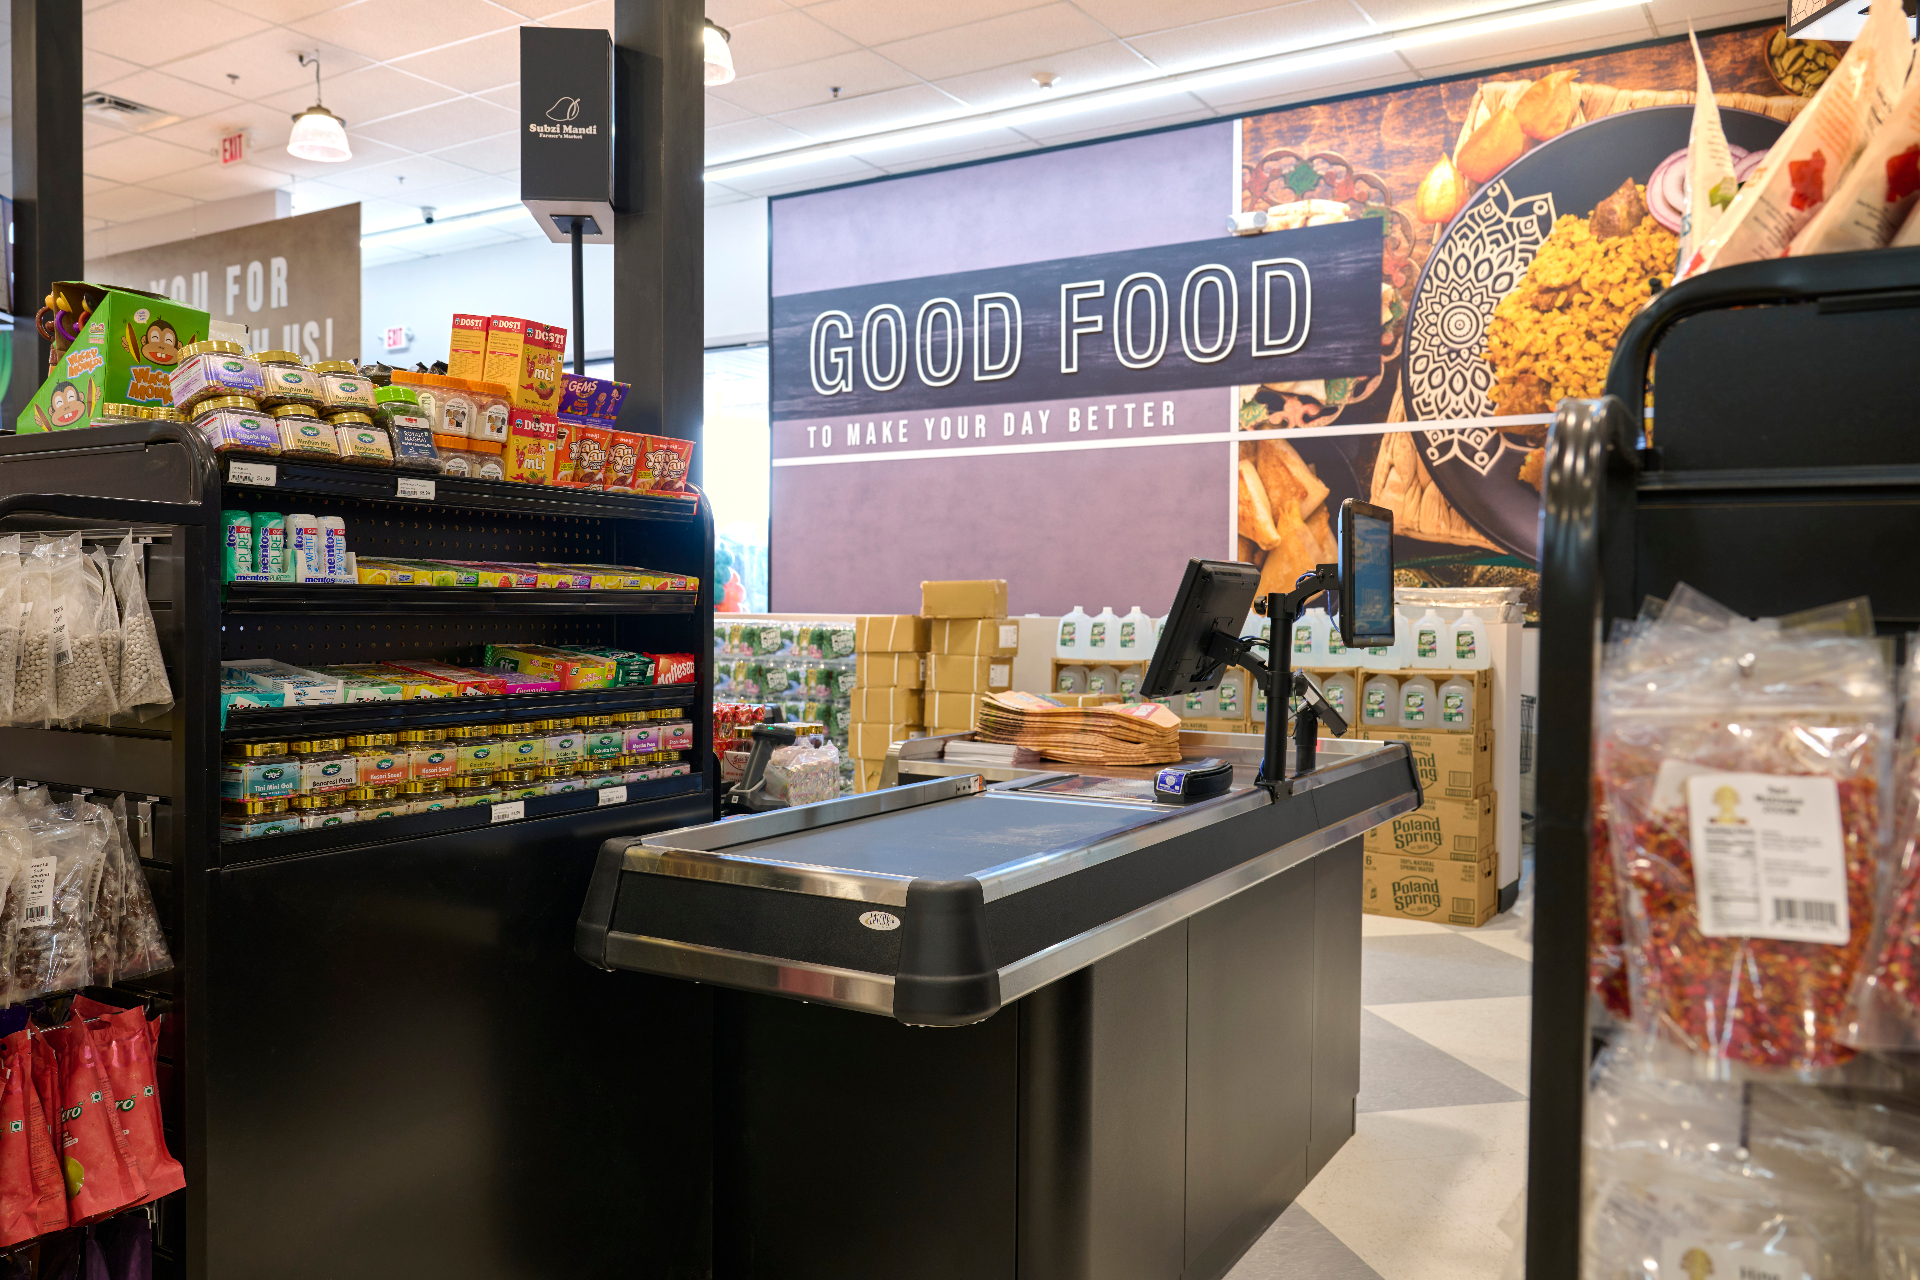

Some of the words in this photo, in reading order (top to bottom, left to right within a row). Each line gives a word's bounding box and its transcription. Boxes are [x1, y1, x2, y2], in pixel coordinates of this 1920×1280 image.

[529, 123, 560, 133] Subzi
[562, 124, 597, 135] Mandi
[226, 256, 288, 316] FOR
[460, 318, 482, 327] DOSTI
[499, 319, 521, 330] DOSTI
[809, 291, 1023, 396] GOOD
[1060, 257, 1312, 374] FOOD
[534, 329, 565, 345] DOSTI
[131, 367, 171, 386] WACK
[129, 381, 174, 406] MONK
[568, 380, 599, 393] GEMS
[524, 420, 555, 434] DOSTI
[807, 425, 833, 449] TO
[846, 419, 909, 447] MAKE
[924, 413, 987, 442] YOUR
[1003, 408, 1051, 437] DAY
[1068, 400, 1175, 433] BETTER
[305, 535, 314, 563] WHITE
[500, 661, 515, 673] tic
[1252, 725, 1259, 735] 6
[1414, 753, 1436, 768] and
[1392, 816, 1441, 835] Poland
[1394, 830, 1442, 849] Spring
[1365, 855, 1372, 865] 6
[1413, 859, 1435, 867] NATURAL
[1417, 865, 1435, 873] WATER
[1391, 878, 1440, 897] Poland
[1393, 892, 1441, 911] Spring
